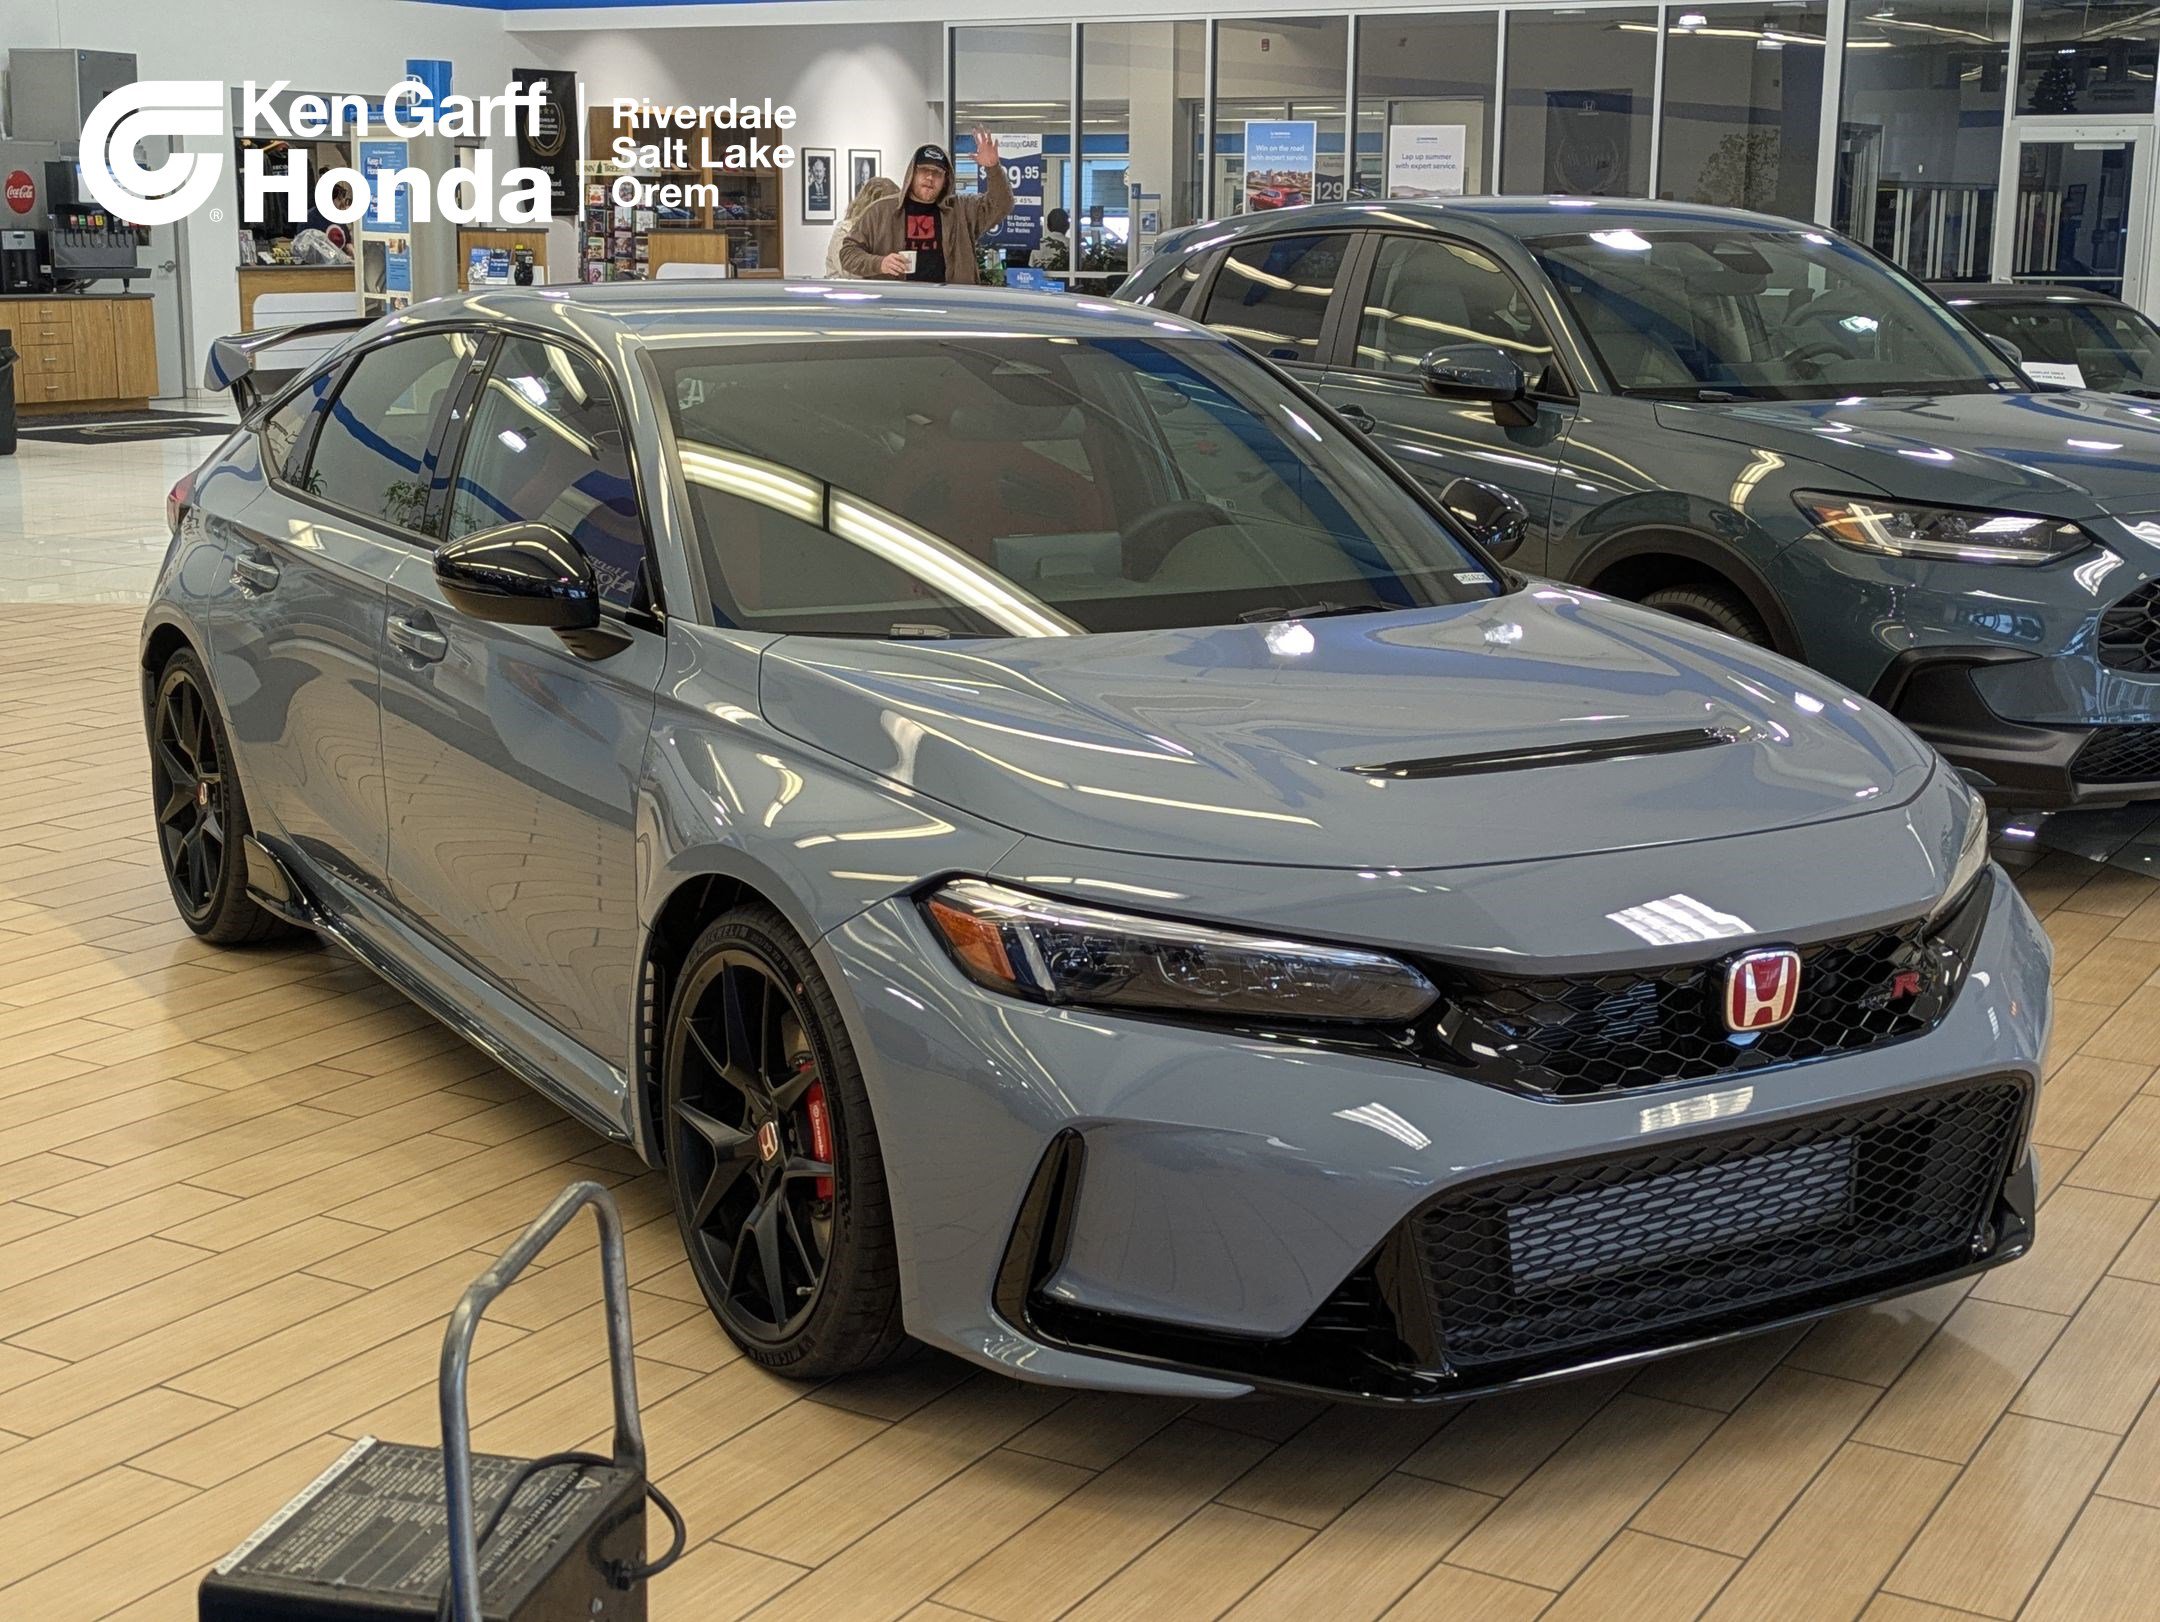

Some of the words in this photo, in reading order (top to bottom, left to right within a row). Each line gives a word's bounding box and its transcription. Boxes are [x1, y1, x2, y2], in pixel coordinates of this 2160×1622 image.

[1255, 144, 1268, 152] Win
[1278, 144, 1289, 152] the
[1289, 144, 1305, 152] road
[1401, 153, 1414, 161] Lap
